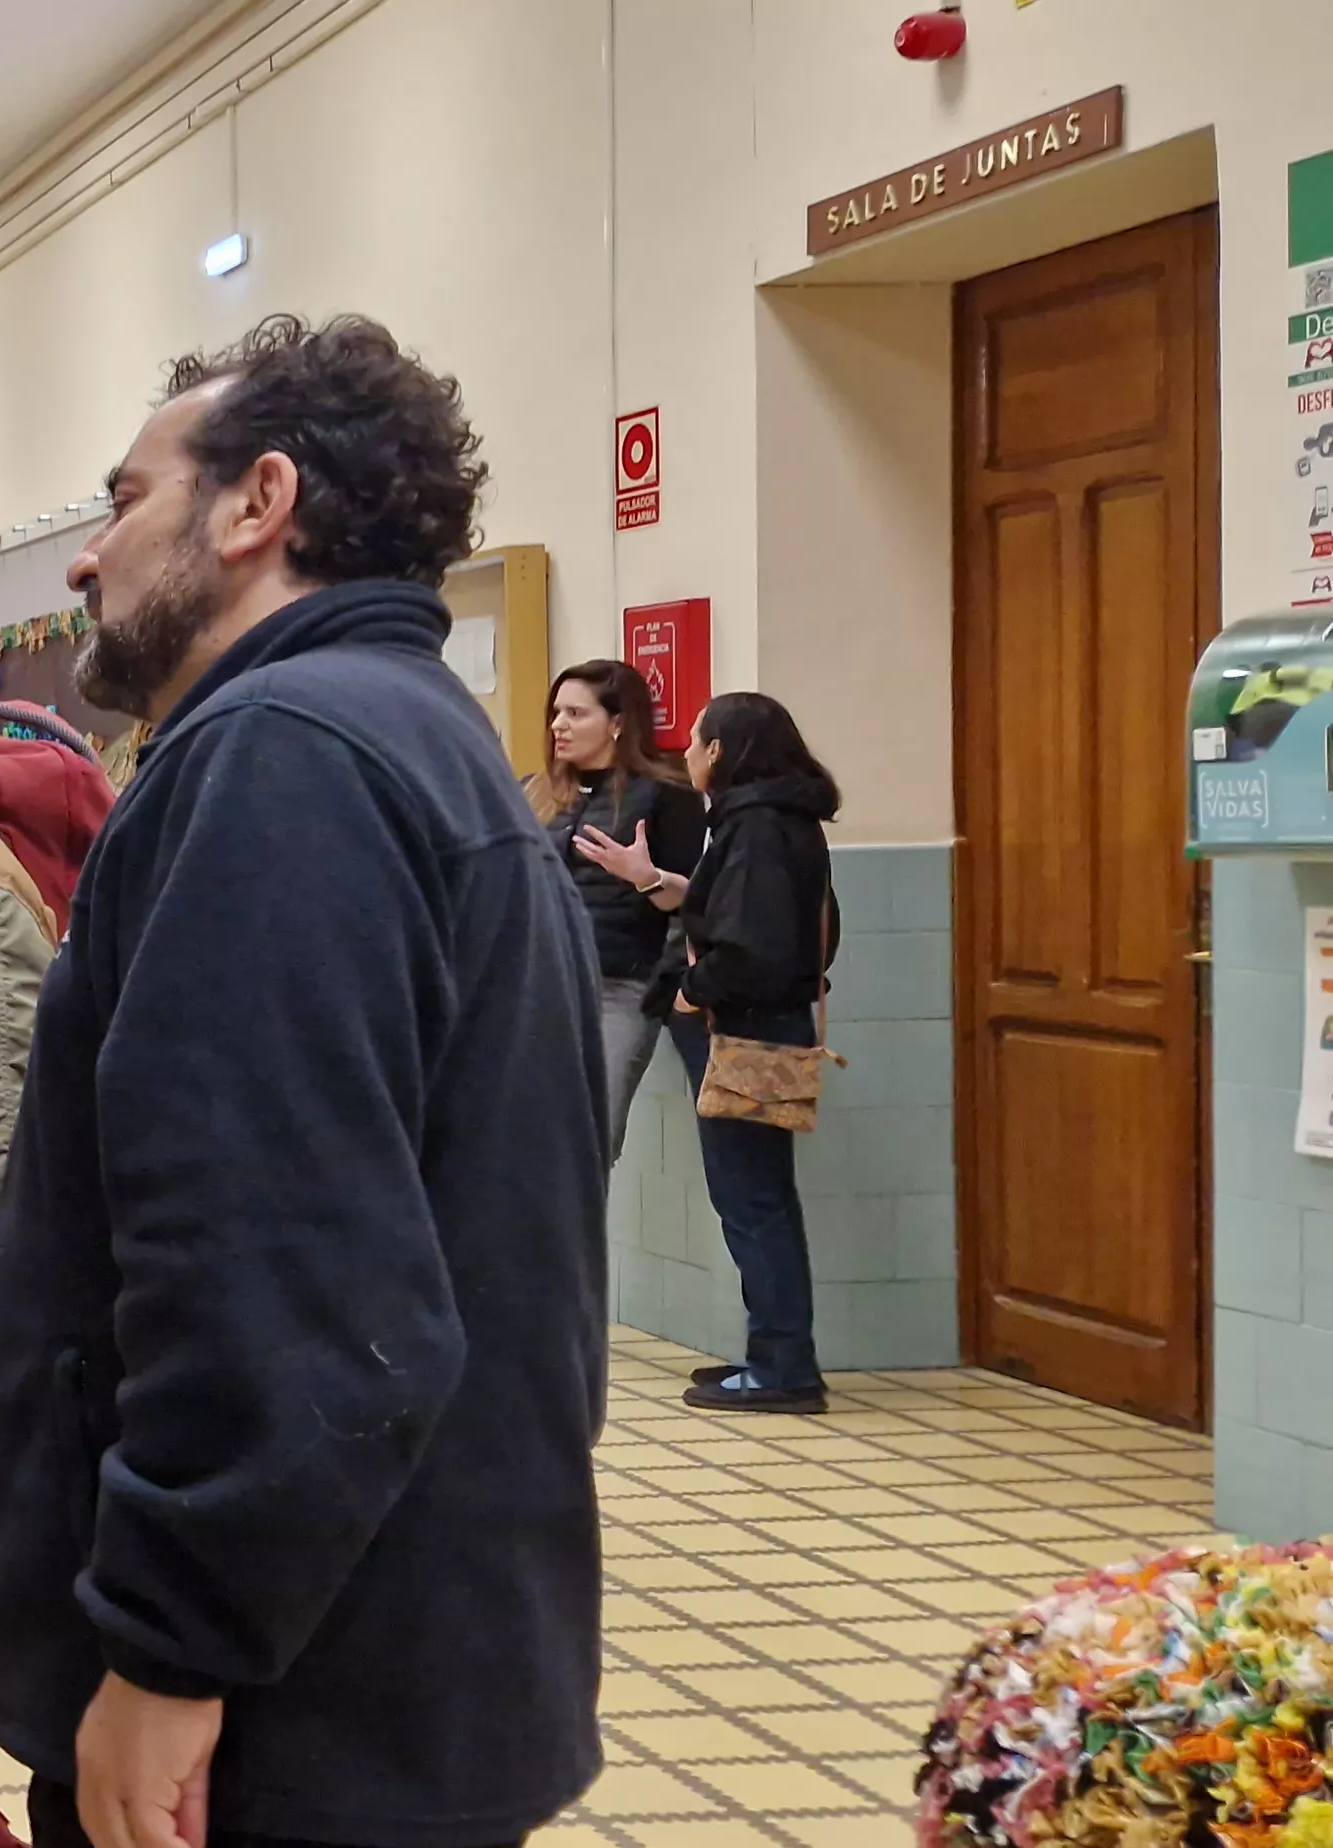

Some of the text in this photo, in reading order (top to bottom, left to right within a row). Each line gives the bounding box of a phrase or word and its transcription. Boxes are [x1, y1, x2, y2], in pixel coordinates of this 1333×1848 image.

[826, 112, 1082, 235] SALA DE JUNTAS
[1204, 780, 1262, 798] SALVA
[1206, 800, 1264, 818] VIDAS
